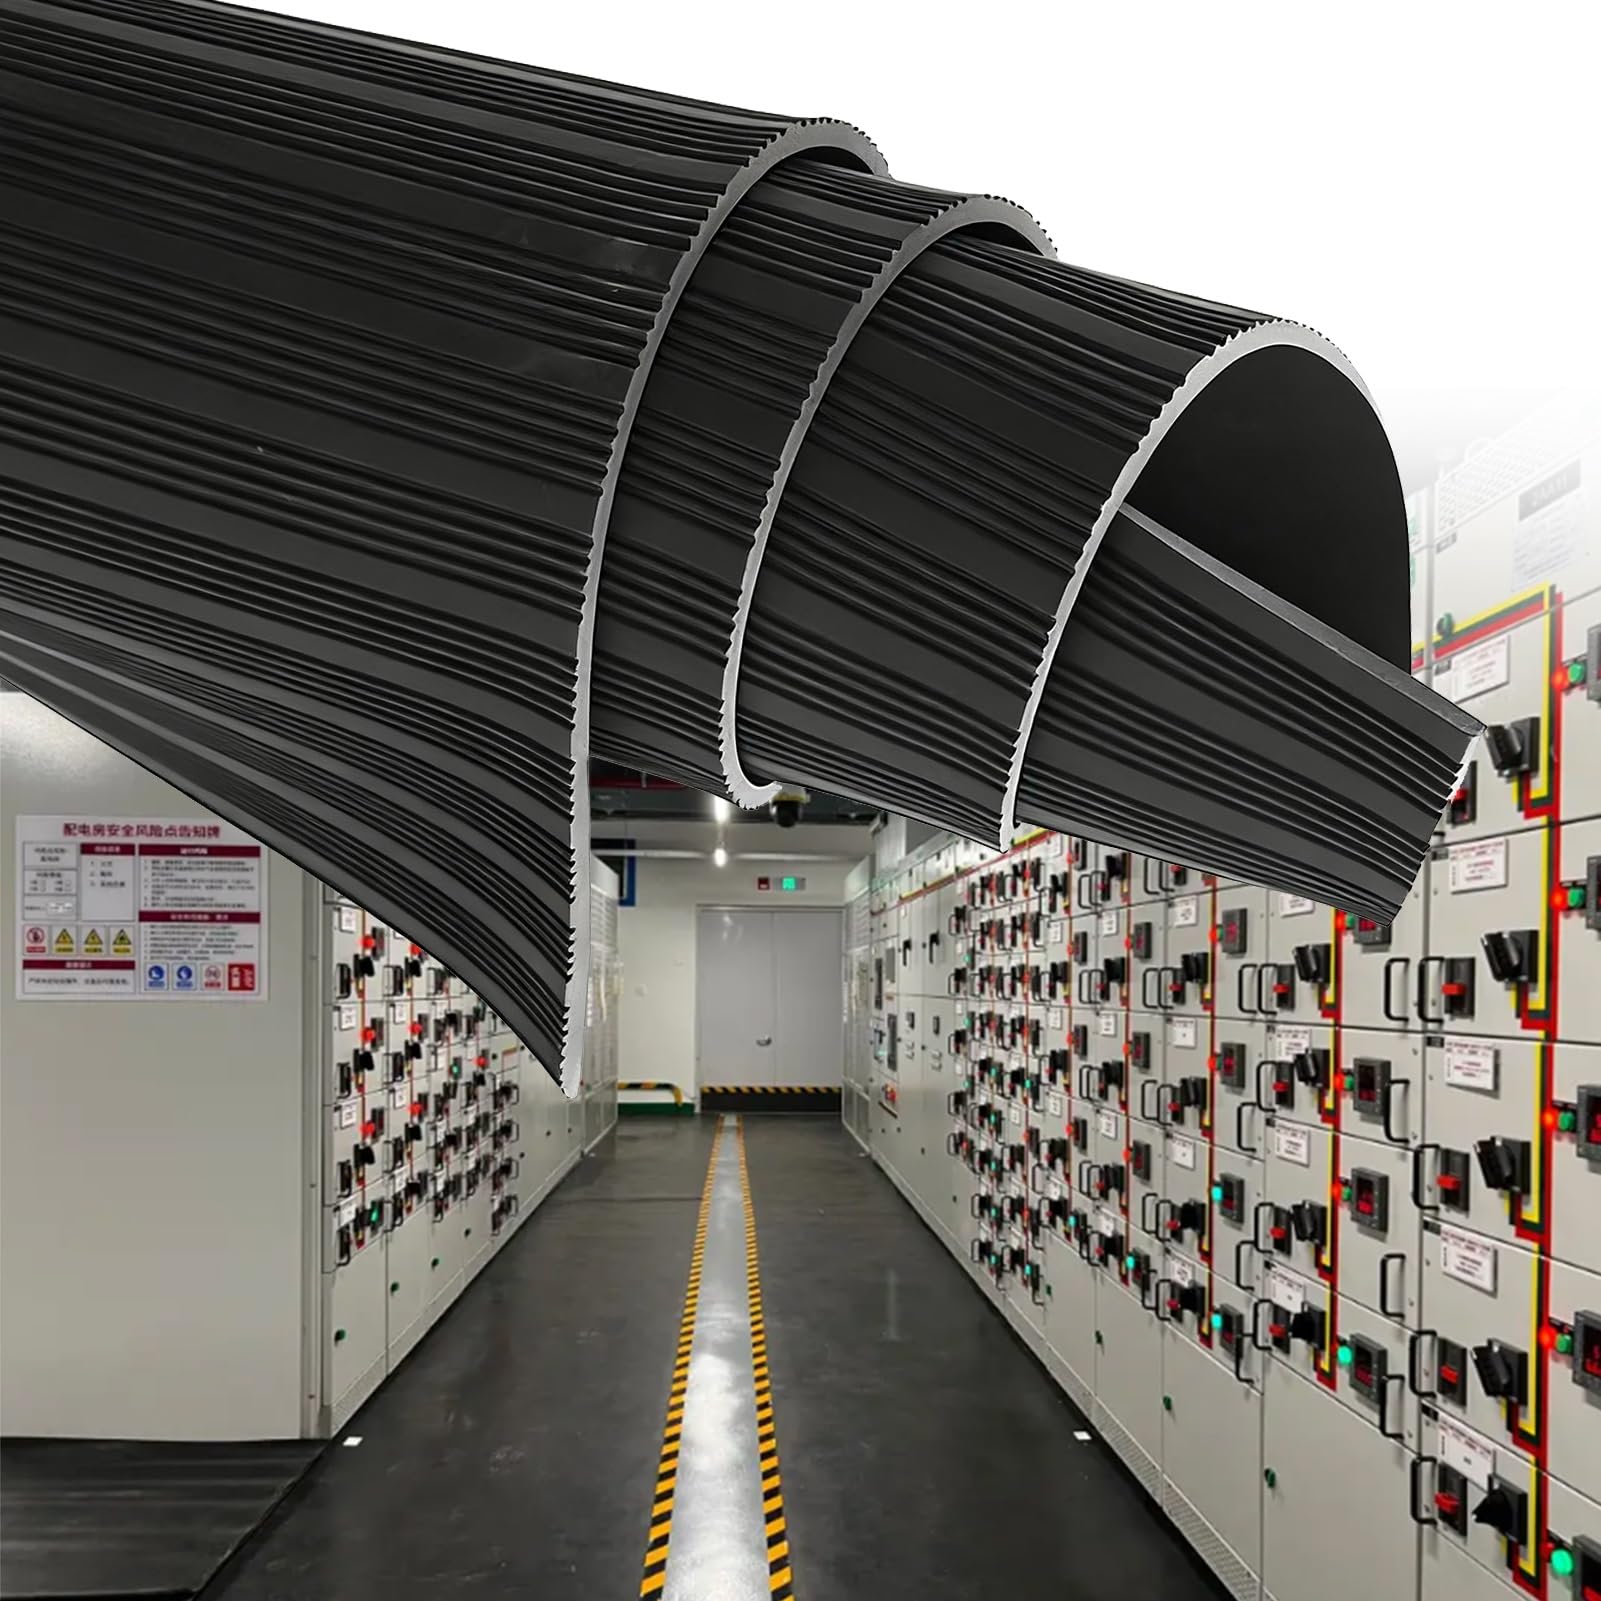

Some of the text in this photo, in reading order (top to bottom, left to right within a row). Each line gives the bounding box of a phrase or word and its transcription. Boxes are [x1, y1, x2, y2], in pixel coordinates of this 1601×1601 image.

[63, 823, 220, 838] 配电房安全风险点告知牌
